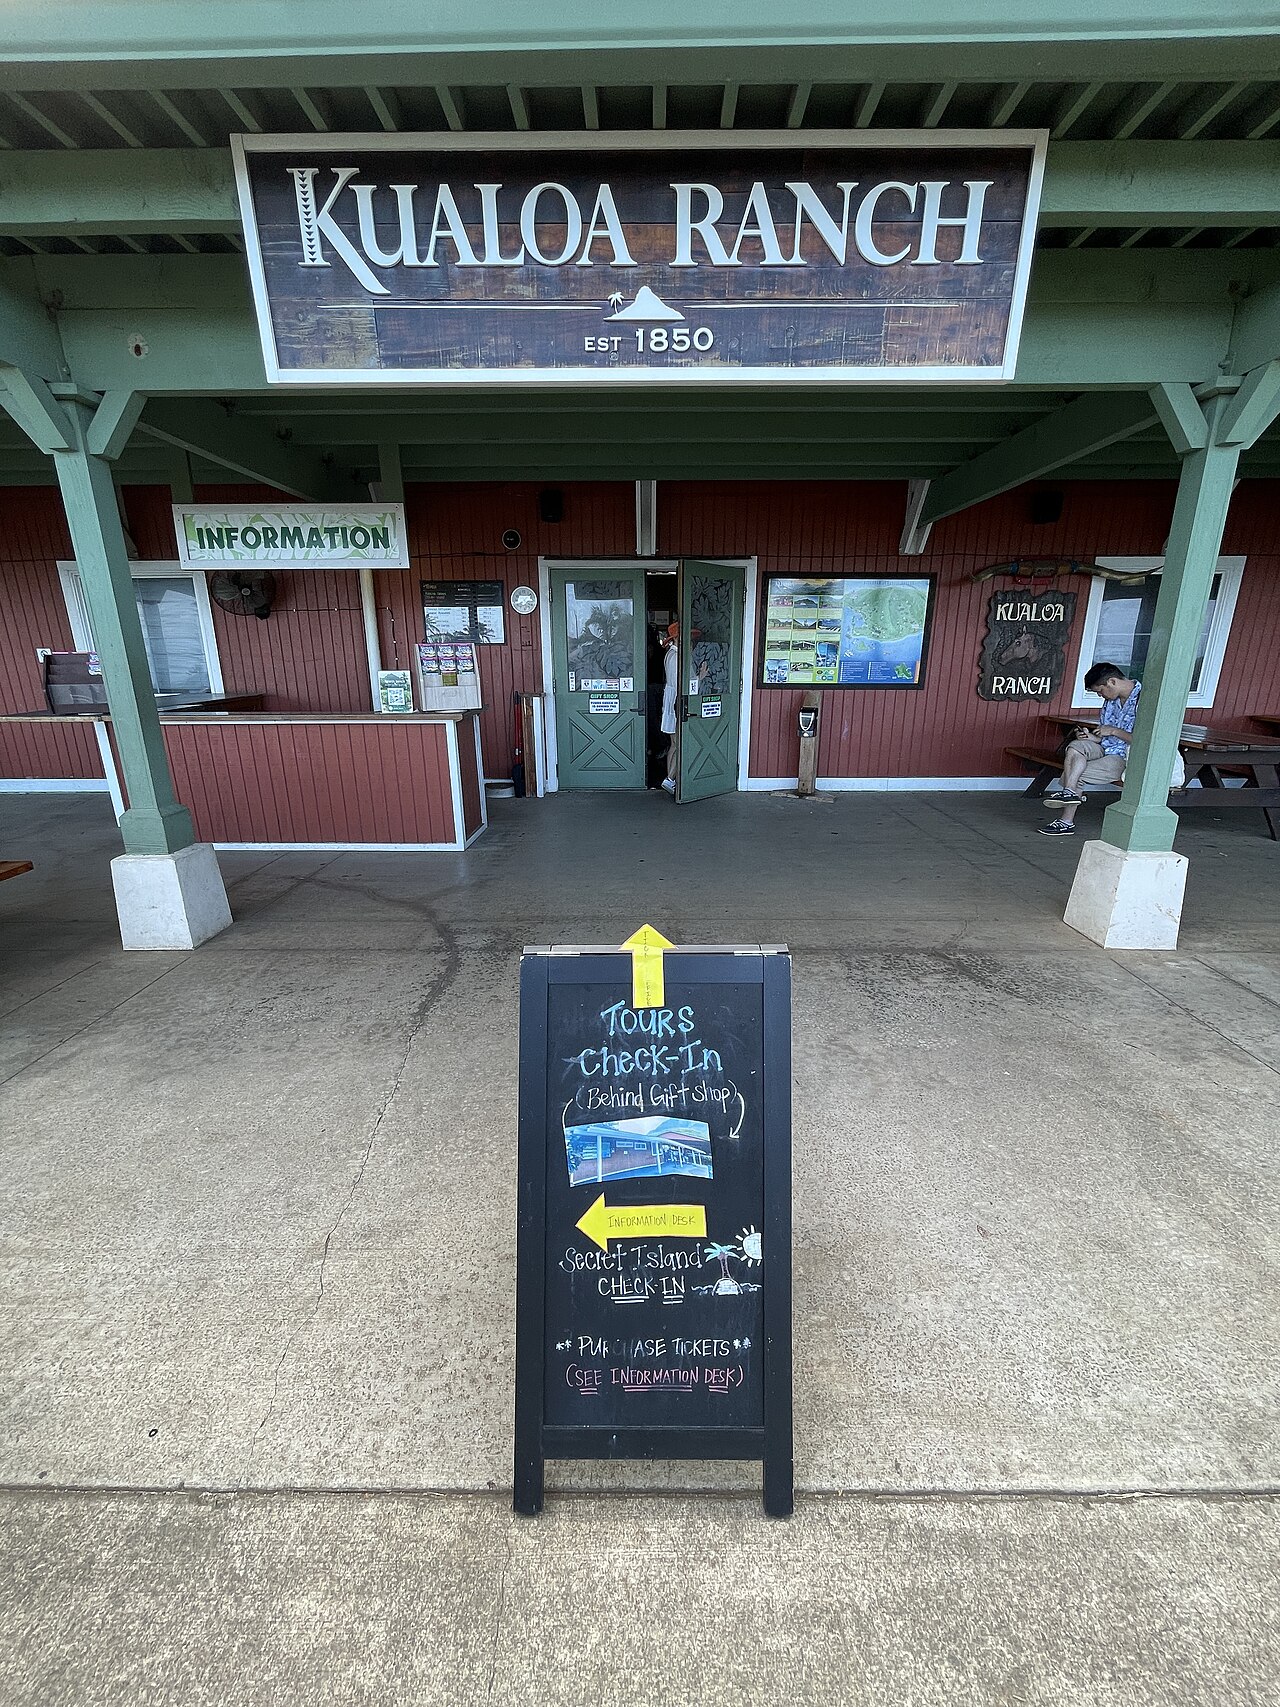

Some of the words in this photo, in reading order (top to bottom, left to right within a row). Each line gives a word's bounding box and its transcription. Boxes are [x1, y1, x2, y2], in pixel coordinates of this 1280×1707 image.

[286, 167, 638, 296] KUALOA
[669, 181, 994, 267] RANCH
[584, 336, 622, 352] EST
[635, 327, 714, 352] 1850
[196, 526, 390, 550] INFORMATION
[996, 602, 1065, 622] KUALOA
[991, 676, 1051, 695] RANCH
[600, 1000, 695, 1037] TOURS
[650, 1082, 690, 1107] Gift
[608, 1213, 667, 1228] INFORMATION
[672, 1213, 696, 1226] DESK
[559, 1243, 628, 1273] Secret
[631, 1243, 703, 1271] Island
[610, 1366, 699, 1385] INFORMATION
